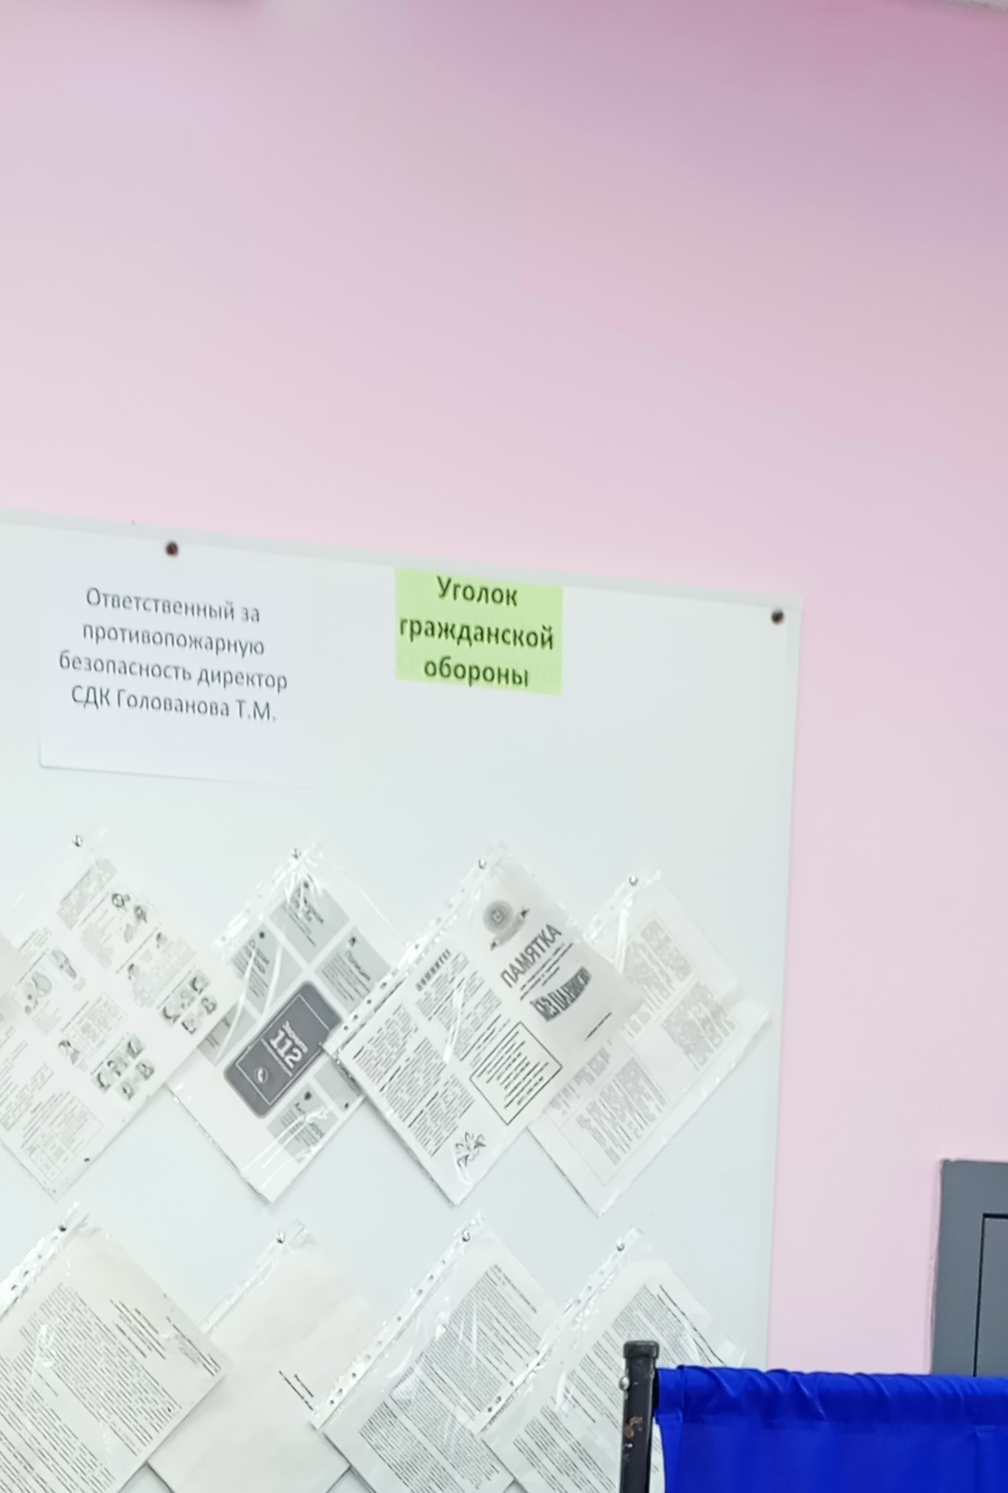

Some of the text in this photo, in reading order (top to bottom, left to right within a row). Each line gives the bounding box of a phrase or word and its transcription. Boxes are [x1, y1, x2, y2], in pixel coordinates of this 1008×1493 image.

[85, 586, 261, 625] Ответственный за
[436, 574, 519, 608] Уголок
[81, 622, 266, 661] противопожарную
[398, 615, 555, 651] гражданской
[58, 649, 289, 696] безопасность директор
[422, 656, 530, 689] обороны
[71, 684, 277, 722] СДК Голованова Т.М.
[500, 923, 563, 989] ПАМЯТКА
[269, 1029, 303, 1069] 112
